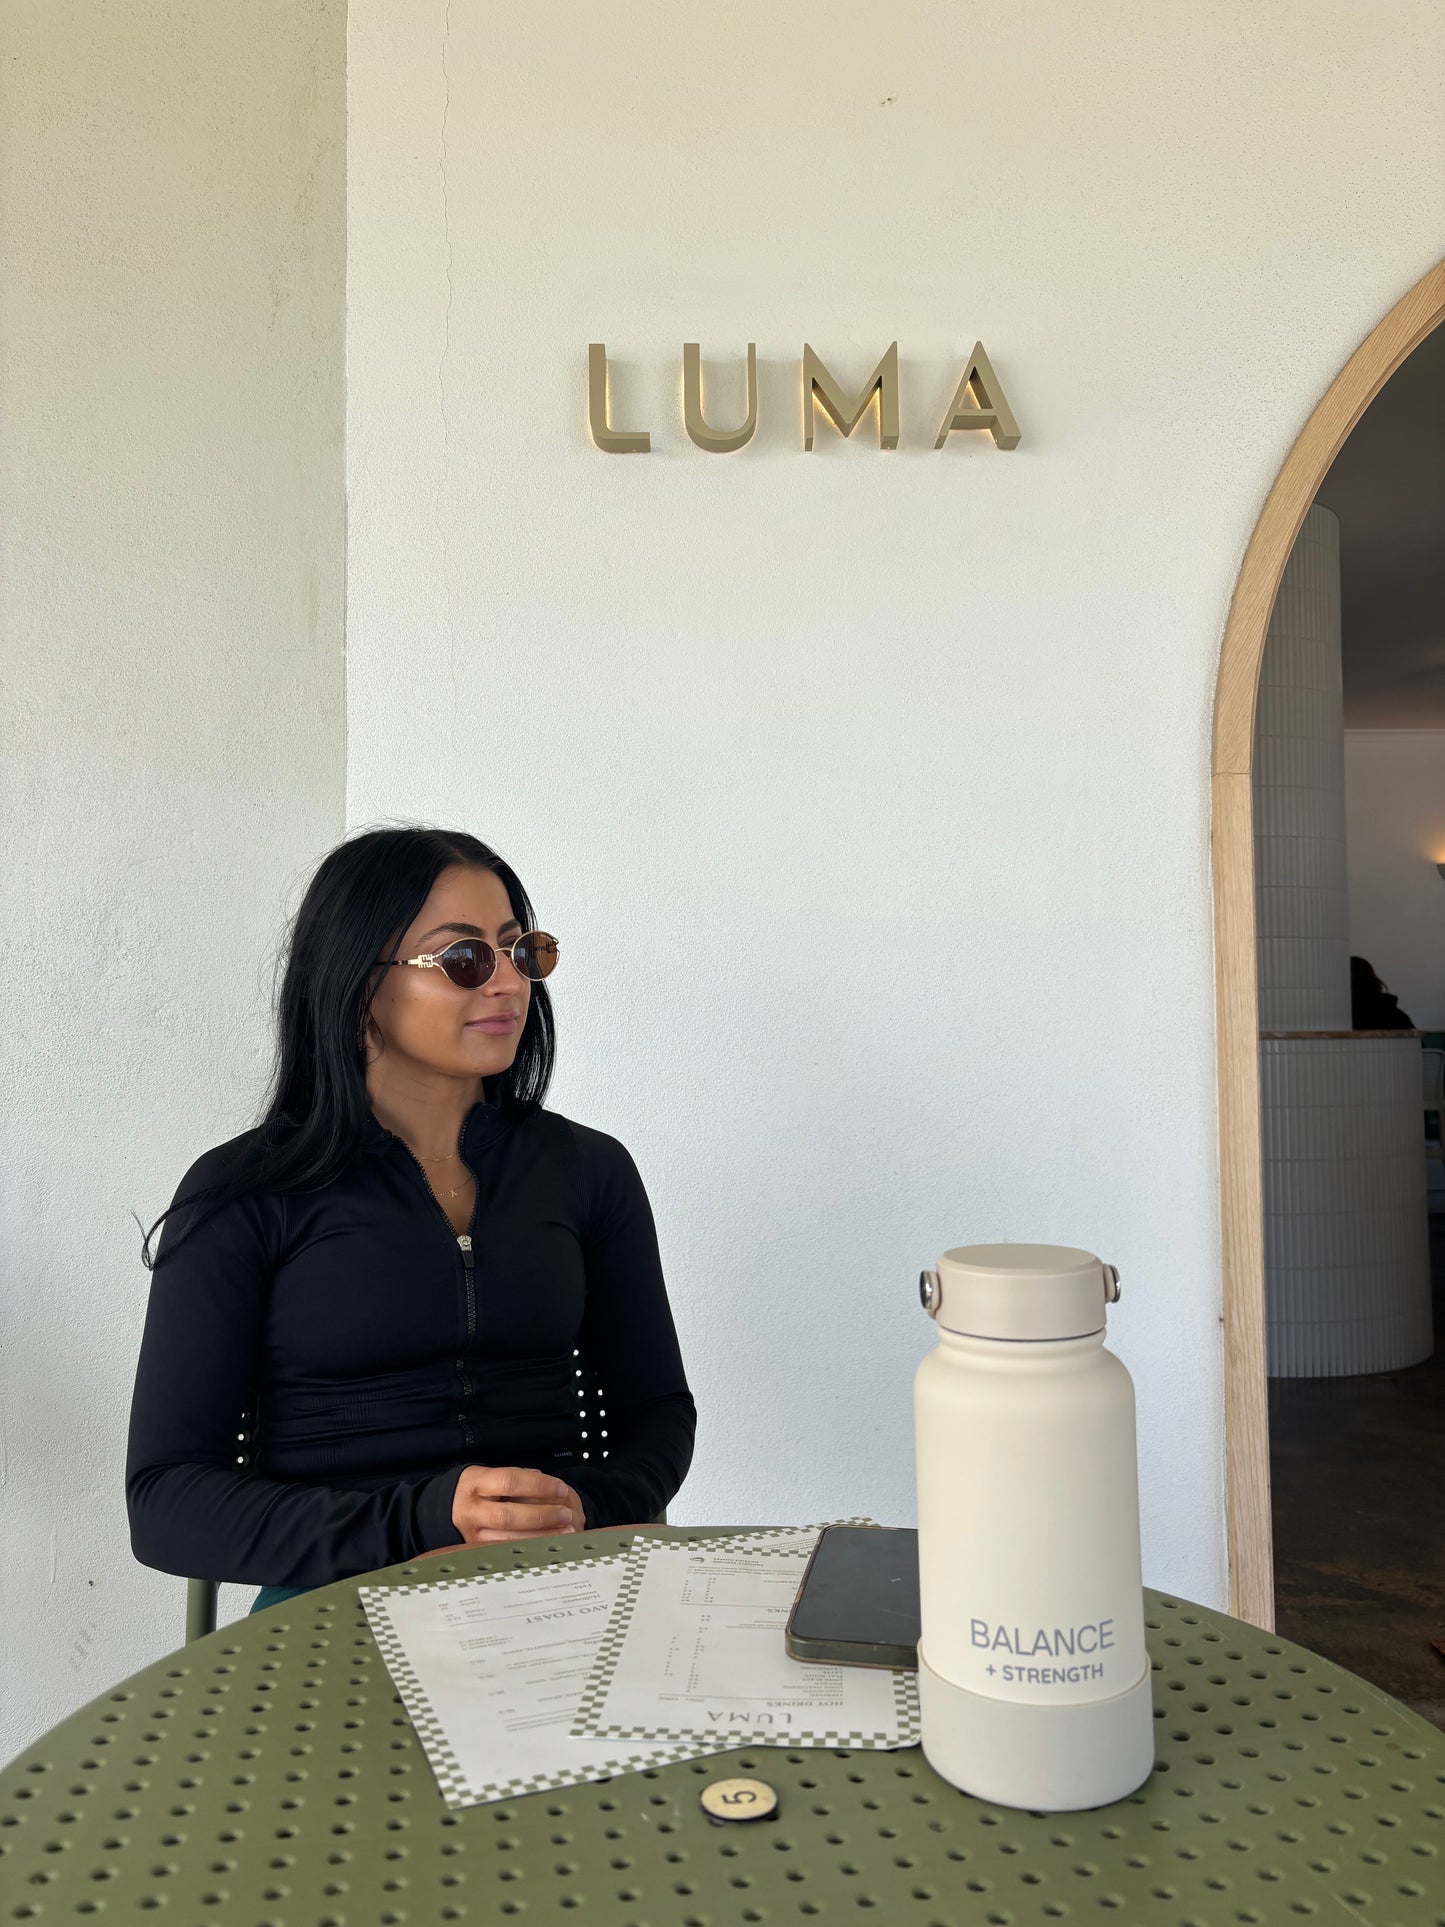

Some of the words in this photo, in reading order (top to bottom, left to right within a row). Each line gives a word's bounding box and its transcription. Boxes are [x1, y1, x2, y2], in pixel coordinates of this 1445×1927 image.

[588, 340, 1022, 452] LUMA
[579, 1603, 608, 1614] AVO
[526, 1610, 576, 1624] TOAST
[970, 1618, 1115, 1656] BALANCE
[1002, 1662, 1104, 1684] STRENGTH
[707, 1711, 792, 1724] LUMA
[721, 1790, 757, 1805] 5
